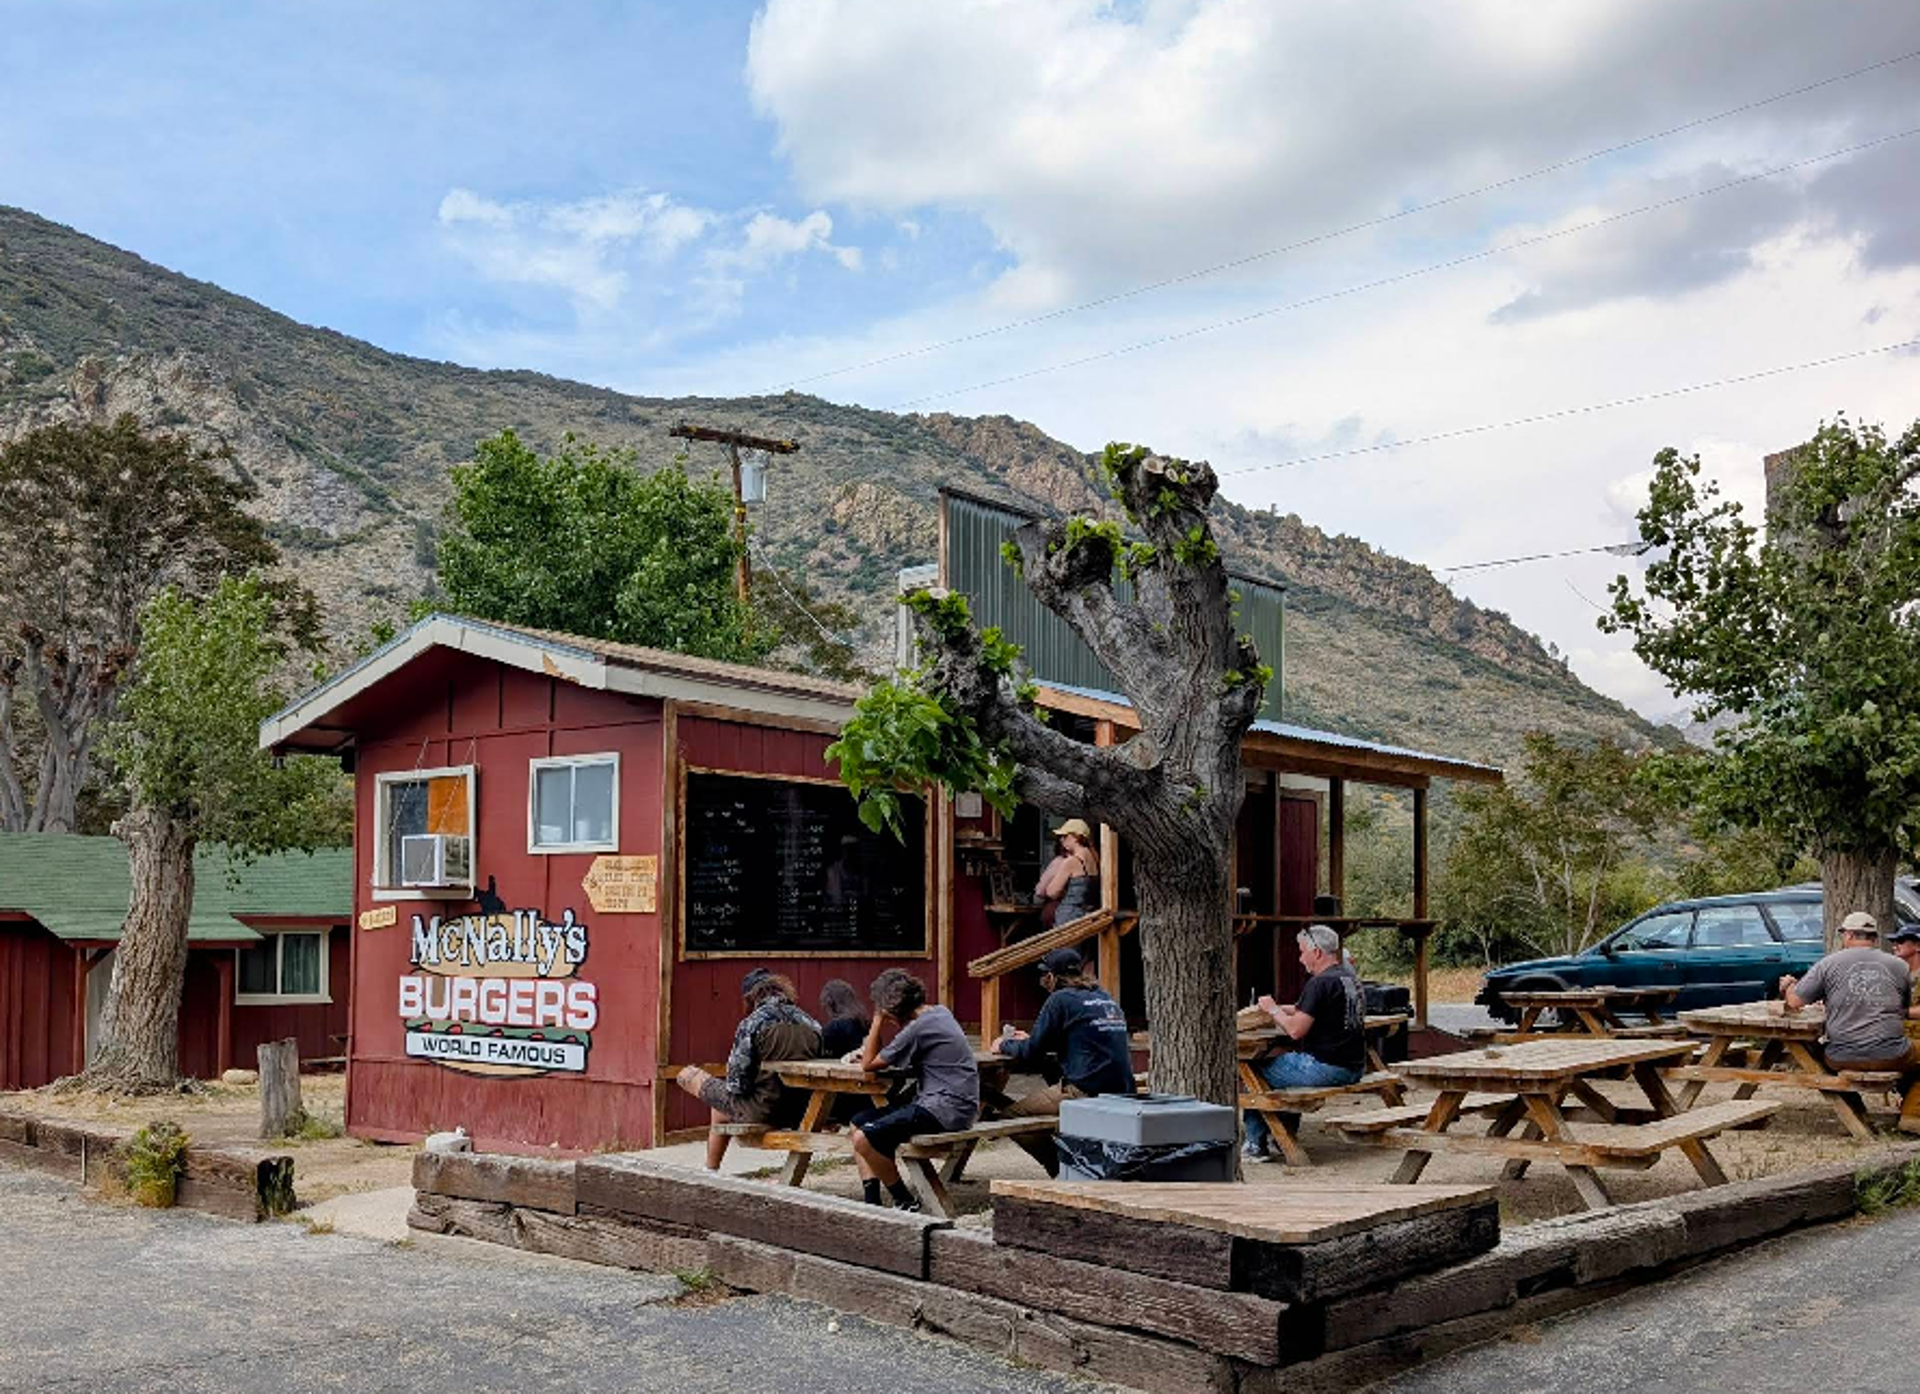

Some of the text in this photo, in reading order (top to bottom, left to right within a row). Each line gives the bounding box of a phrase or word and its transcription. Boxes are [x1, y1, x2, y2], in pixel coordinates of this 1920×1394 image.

[410, 909, 587, 976] McNally's
[399, 975, 598, 1030] BURGERS
[422, 1037, 566, 1064] WORLD FAMOUS
